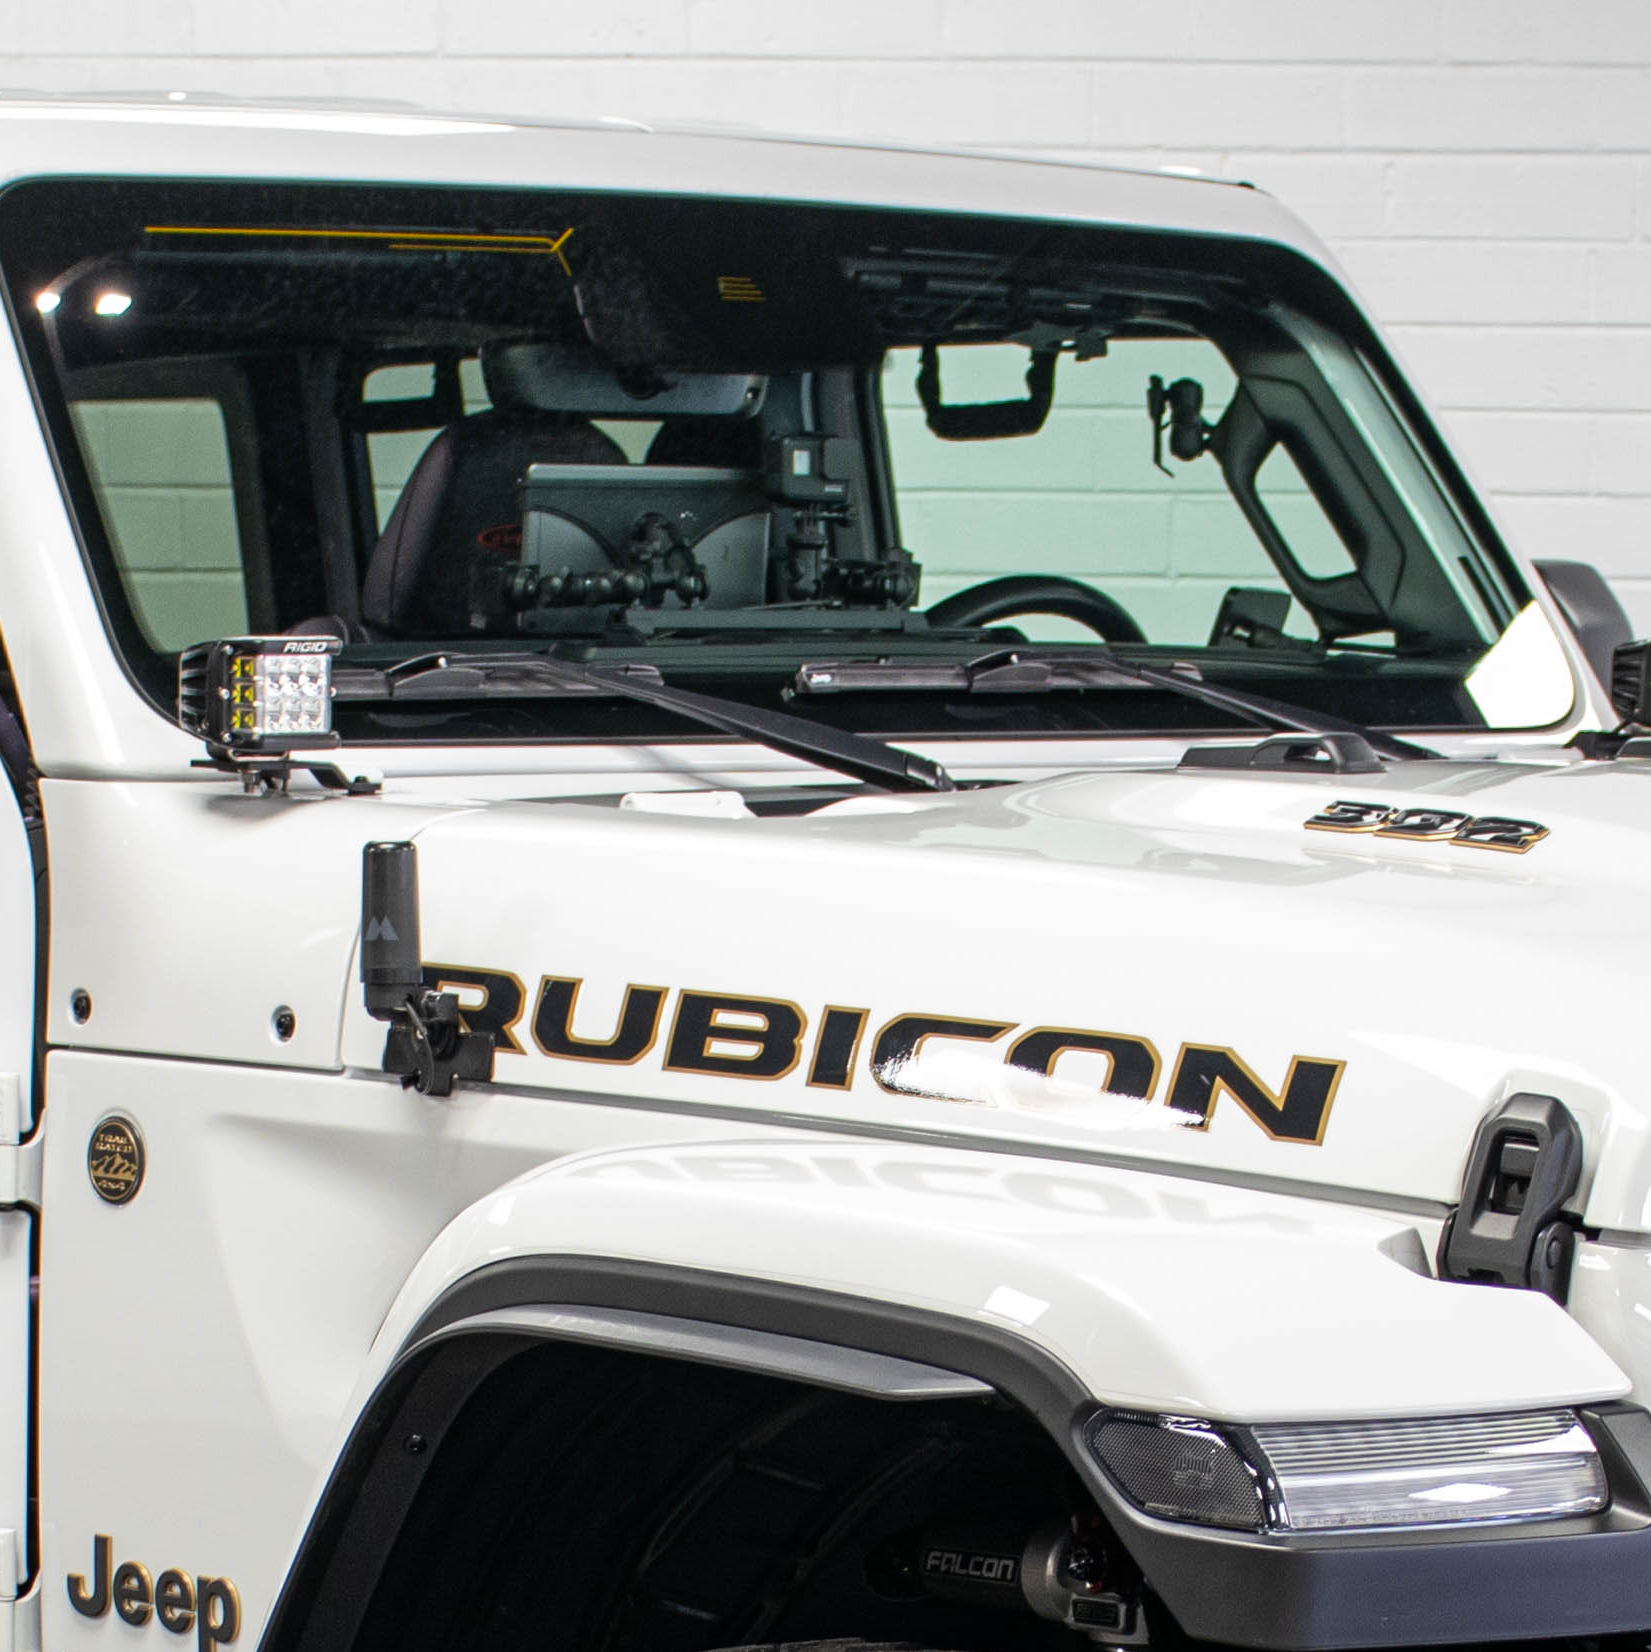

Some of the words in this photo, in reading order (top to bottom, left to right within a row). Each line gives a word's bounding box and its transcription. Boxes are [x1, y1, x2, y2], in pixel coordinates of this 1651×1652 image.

[283, 641, 328, 653] RIGID
[1302, 799, 1551, 855] 392
[420, 960, 1349, 1148] RUBICON
[95, 1142, 133, 1153] RATED
[99, 1134, 128, 1143] TRAIL
[925, 1549, 1017, 1581] FALCON
